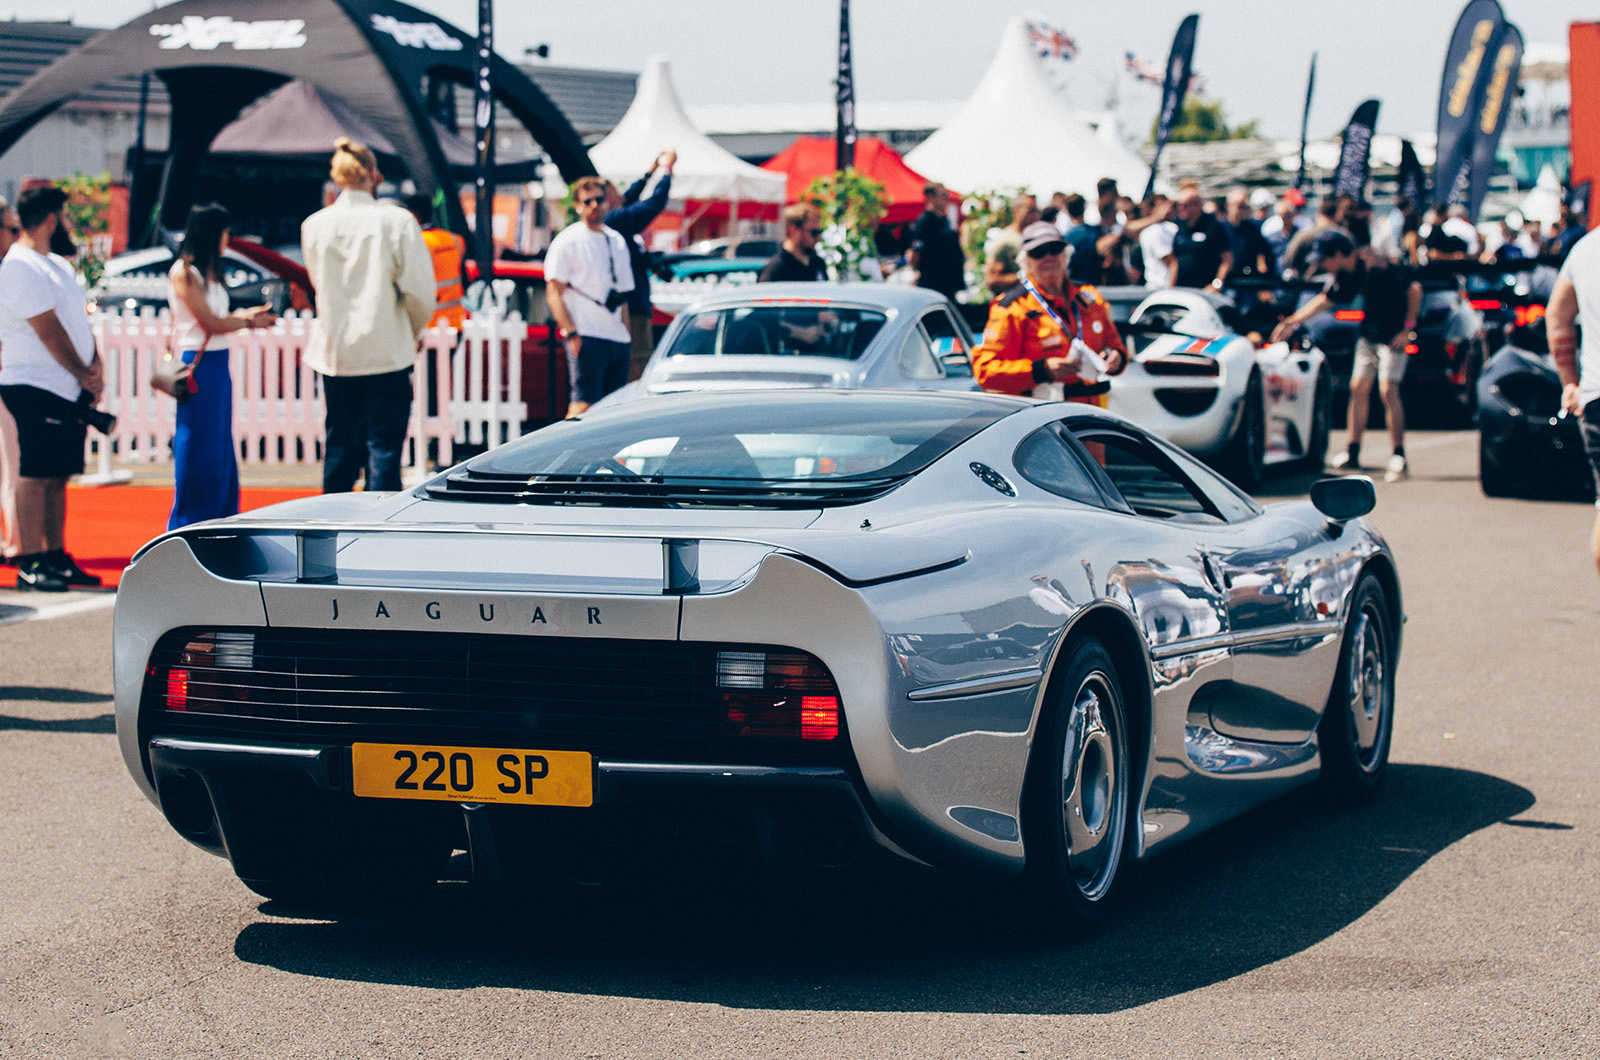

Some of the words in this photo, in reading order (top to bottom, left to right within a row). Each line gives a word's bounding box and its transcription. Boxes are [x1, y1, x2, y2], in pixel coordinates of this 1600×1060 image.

[332, 598, 602, 625] JAGUAR
[394, 750, 474, 792] 220
[496, 754, 549, 795] SP
